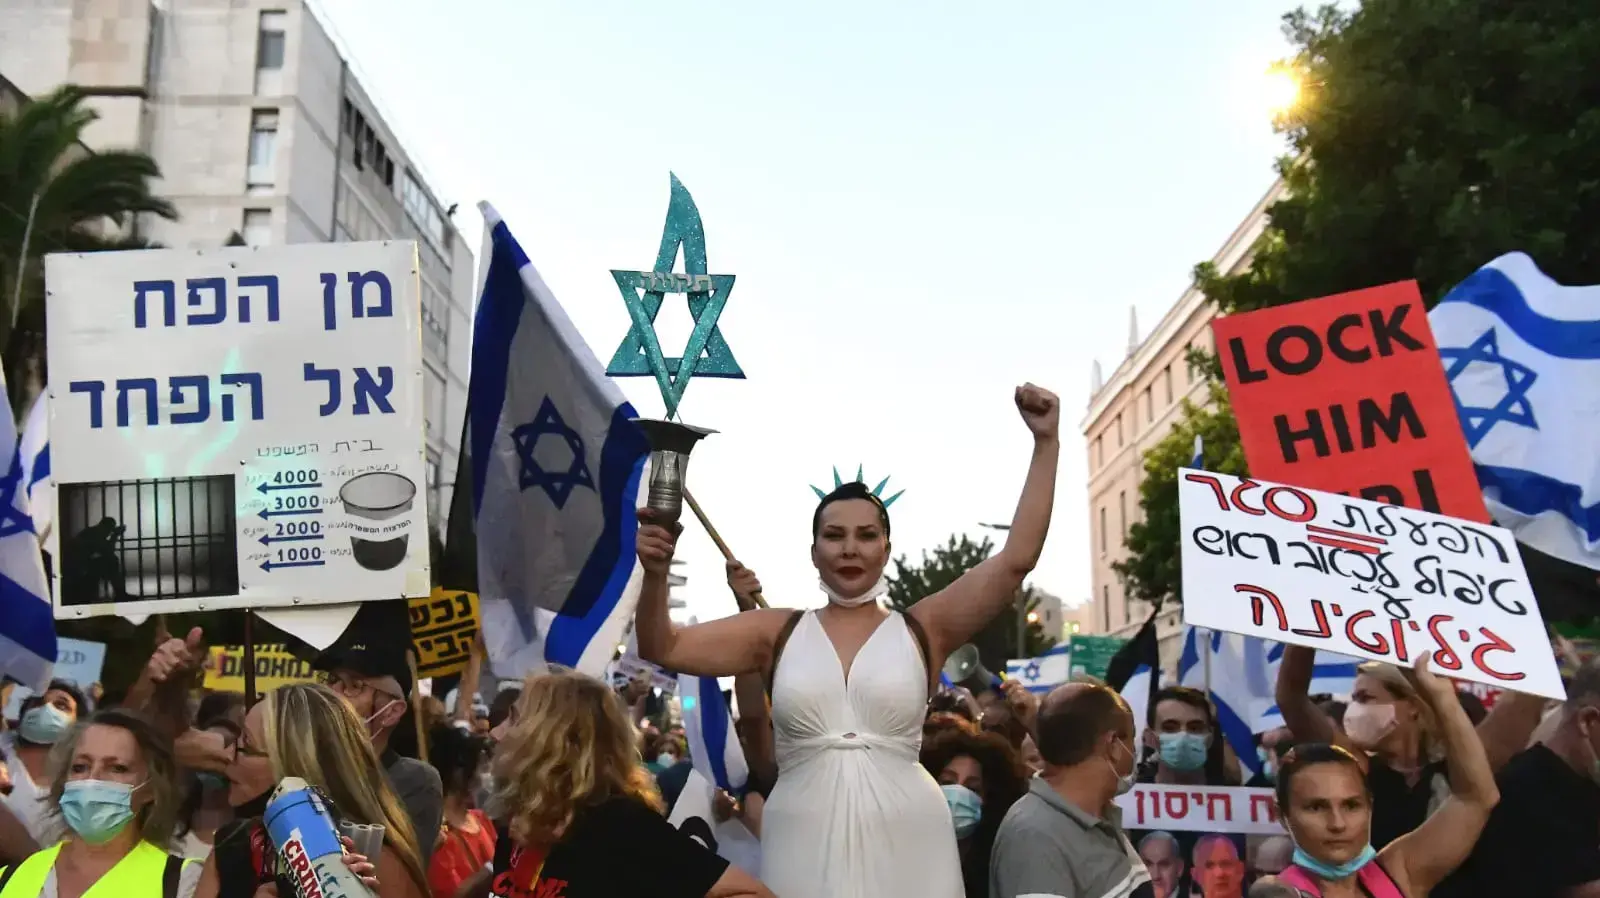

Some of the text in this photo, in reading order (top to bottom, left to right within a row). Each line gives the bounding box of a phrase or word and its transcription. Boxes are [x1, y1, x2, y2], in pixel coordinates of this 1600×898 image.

[133, 270, 393, 330] מן הפח
[1229, 303, 1425, 384] LOCK
[69, 362, 396, 428] אל הפחד
[331, 439, 383, 453] בית
[1273, 391, 1427, 463] HIM
[273, 469, 319, 484] 4000
[1185, 474, 1318, 523] סגר
[274, 495, 320, 510] 3000
[275, 521, 321, 536] 2000
[1192, 525, 1281, 565] ראש
[1333, 504, 1510, 564] הפעלת
[277, 546, 321, 562] 1000
[1413, 555, 1528, 616] טיפול
[1134, 790, 1233, 825] חיסון
